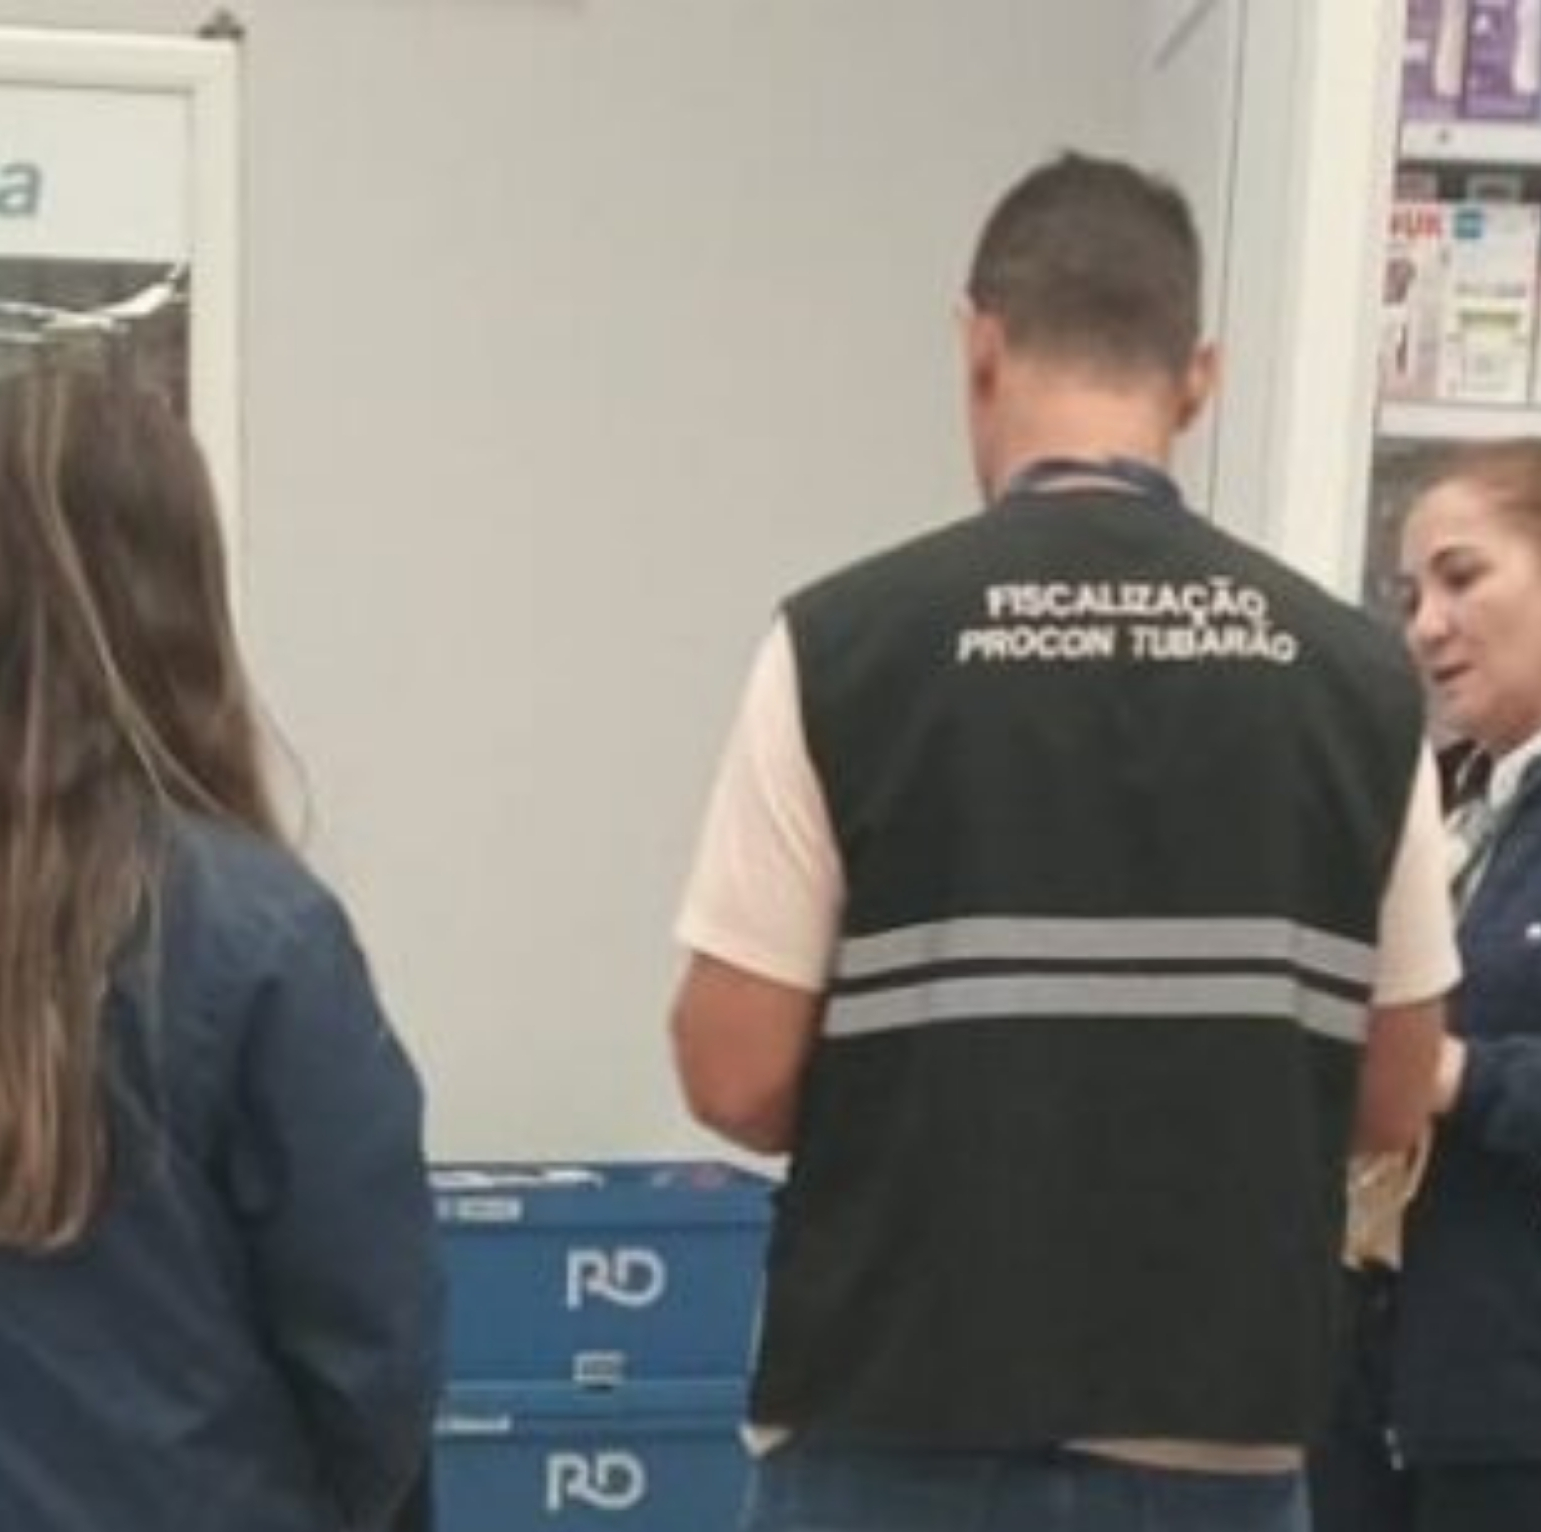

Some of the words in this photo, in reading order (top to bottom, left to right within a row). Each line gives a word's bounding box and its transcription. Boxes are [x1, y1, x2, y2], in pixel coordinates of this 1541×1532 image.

[985, 577, 1272, 627] FISCALIZAÇÃO
[955, 625, 1115, 664] PROCON
[1127, 617, 1300, 664] TUBARÃO
[565, 1246, 667, 1312] RD
[545, 1450, 647, 1512] RD
